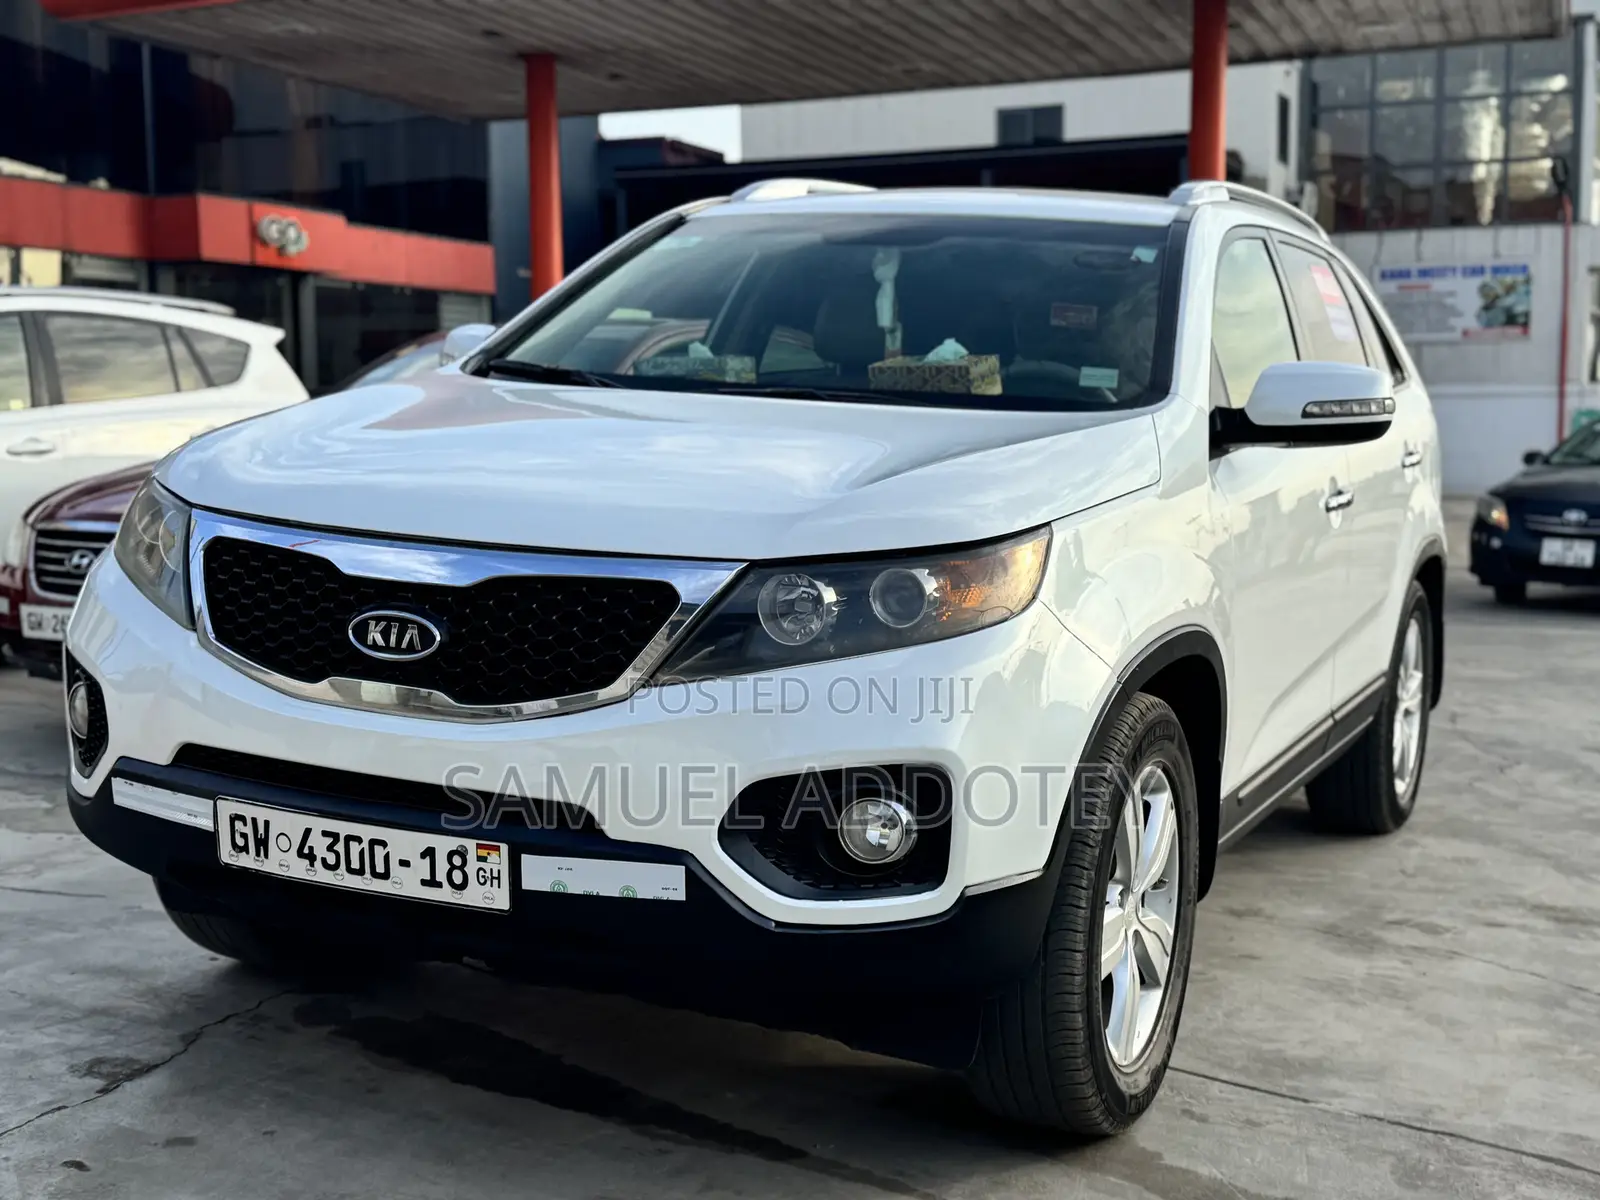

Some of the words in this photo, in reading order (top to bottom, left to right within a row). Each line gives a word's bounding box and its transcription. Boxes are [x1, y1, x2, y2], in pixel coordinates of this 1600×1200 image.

[367, 620, 422, 650] KIA
[229, 813, 270, 859] GW
[297, 827, 469, 891] 4300-18
[476, 867, 501, 889] GH
